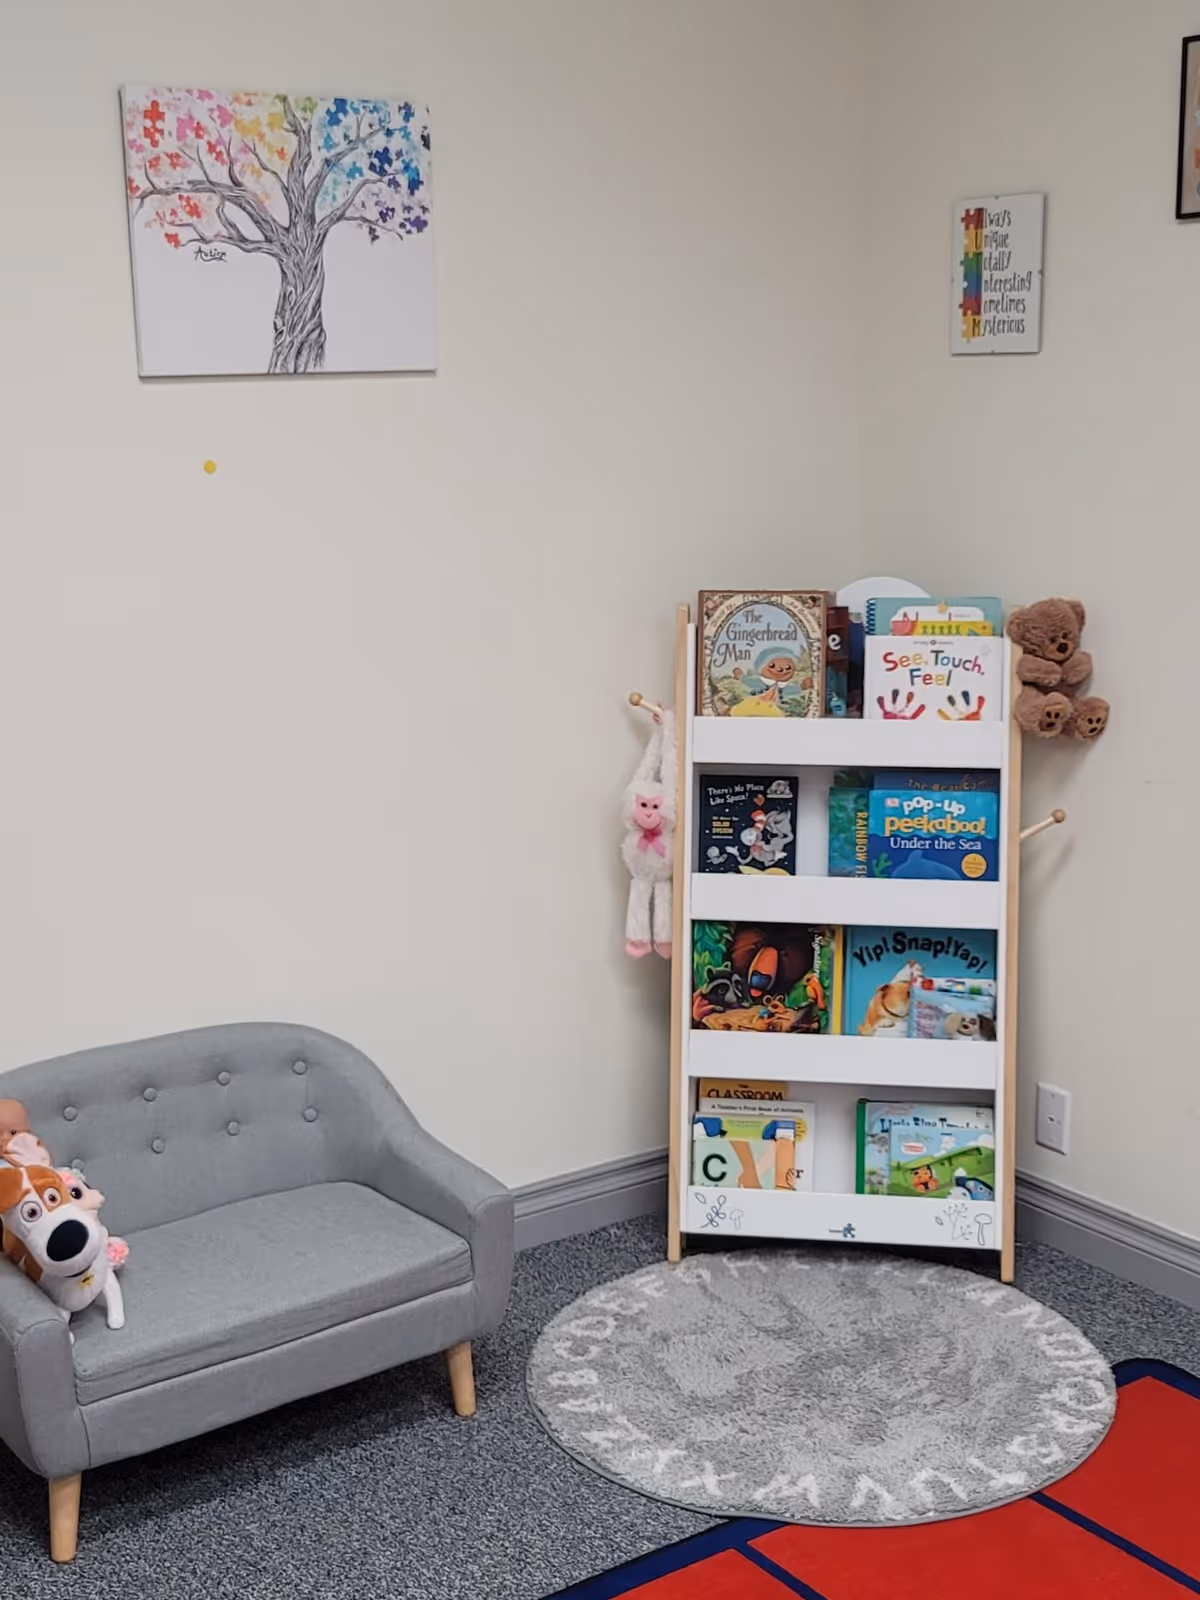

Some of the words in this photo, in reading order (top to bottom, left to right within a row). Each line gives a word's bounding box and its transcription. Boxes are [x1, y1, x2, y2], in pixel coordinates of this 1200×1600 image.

[974, 230, 1009, 251] Unique
[973, 271, 1032, 293] nteresting
[972, 293, 1026, 314] ometimes
[972, 316, 1025, 337] Mysterious
[743, 608, 763, 623] The
[726, 622, 798, 647] Gingerbread
[713, 643, 751, 668] Man
[930, 650, 985, 676] Touch,
[909, 667, 952, 687] Feel
[734, 784, 744, 792] No
[710, 797, 725, 806] Like
[884, 814, 986, 837] peekaboo!
[856, 812, 868, 863] RAINBOW
[890, 837, 931, 850] Under
[934, 837, 955, 850] the
[958, 839, 982, 850] Sea
[852, 936, 890, 967] Yip!
[891, 930, 951, 959] Snap!
[949, 938, 988, 974] Yap!
[707, 1088, 784, 1100] CLASSROOM
